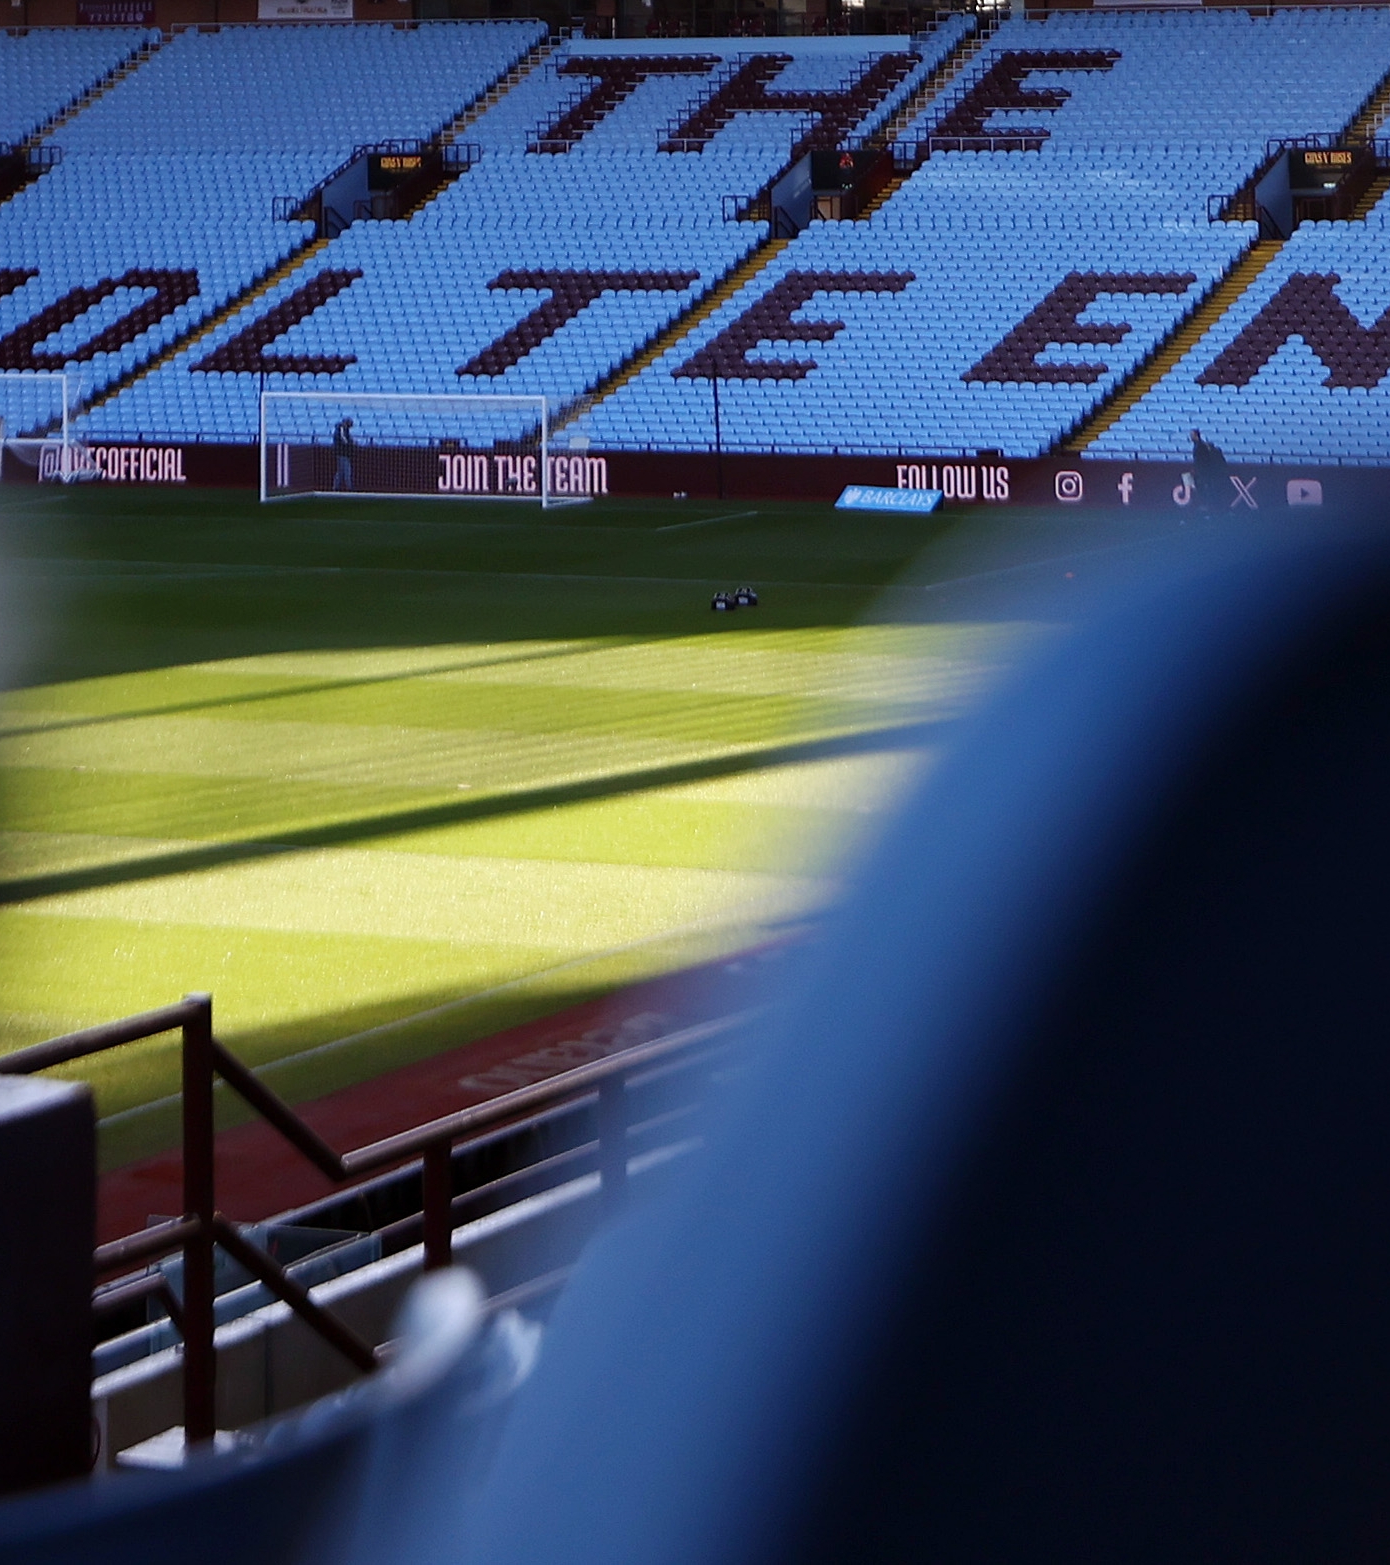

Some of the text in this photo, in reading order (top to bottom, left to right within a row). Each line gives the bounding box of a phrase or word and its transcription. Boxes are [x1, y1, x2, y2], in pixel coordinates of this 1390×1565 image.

[525, 49, 1122, 154] THE
[438, 453, 610, 495] JOIN THE TEAM
[895, 464, 977, 499] FOLLOW
[980, 465, 1010, 501] US
[860, 488, 936, 507] BARCLAYS
